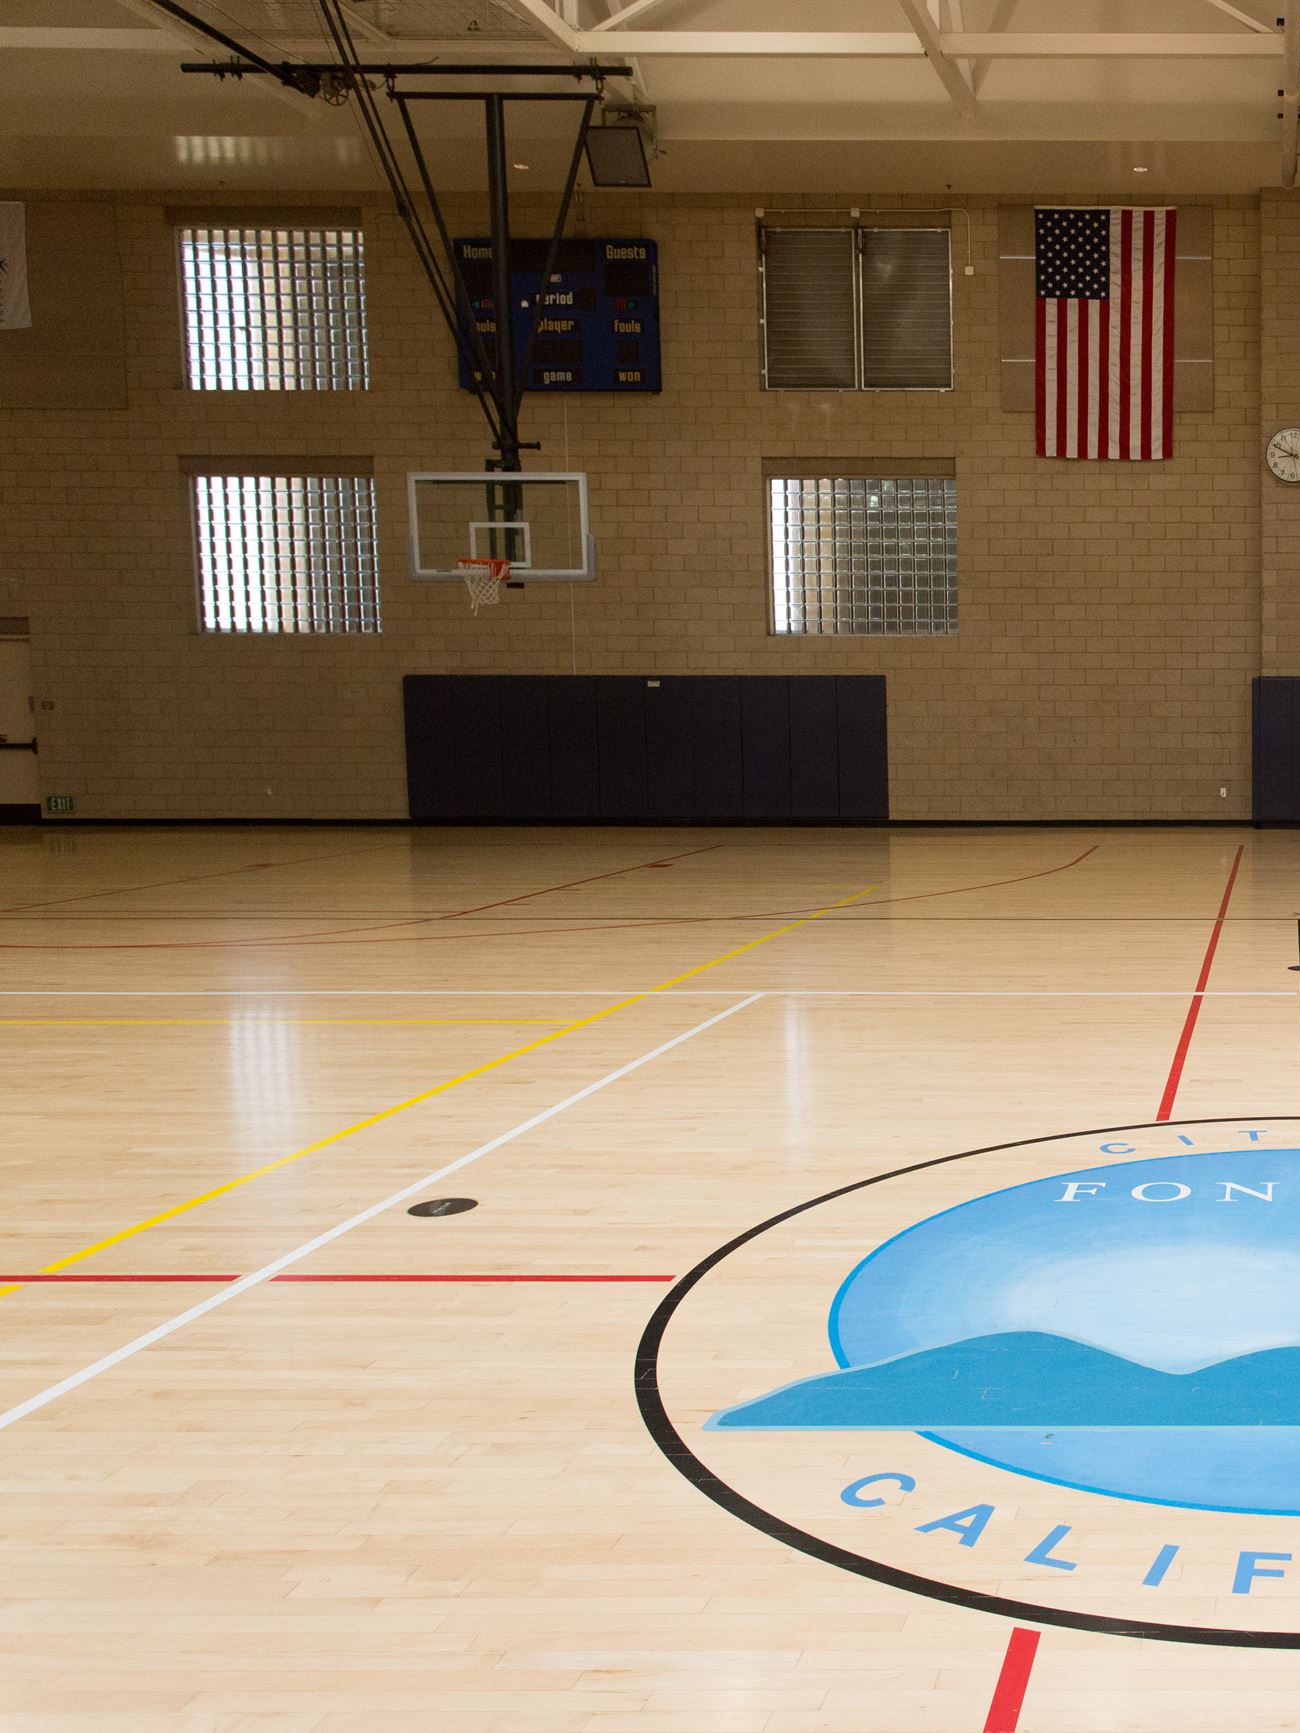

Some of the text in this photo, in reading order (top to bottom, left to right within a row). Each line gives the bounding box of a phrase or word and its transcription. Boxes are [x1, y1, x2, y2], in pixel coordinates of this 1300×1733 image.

[606, 245, 646, 260] Guests
[614, 319, 641, 333] fouls
[543, 370, 573, 385] game
[618, 370, 641, 382] won
[50, 797, 71, 811] EXIT
